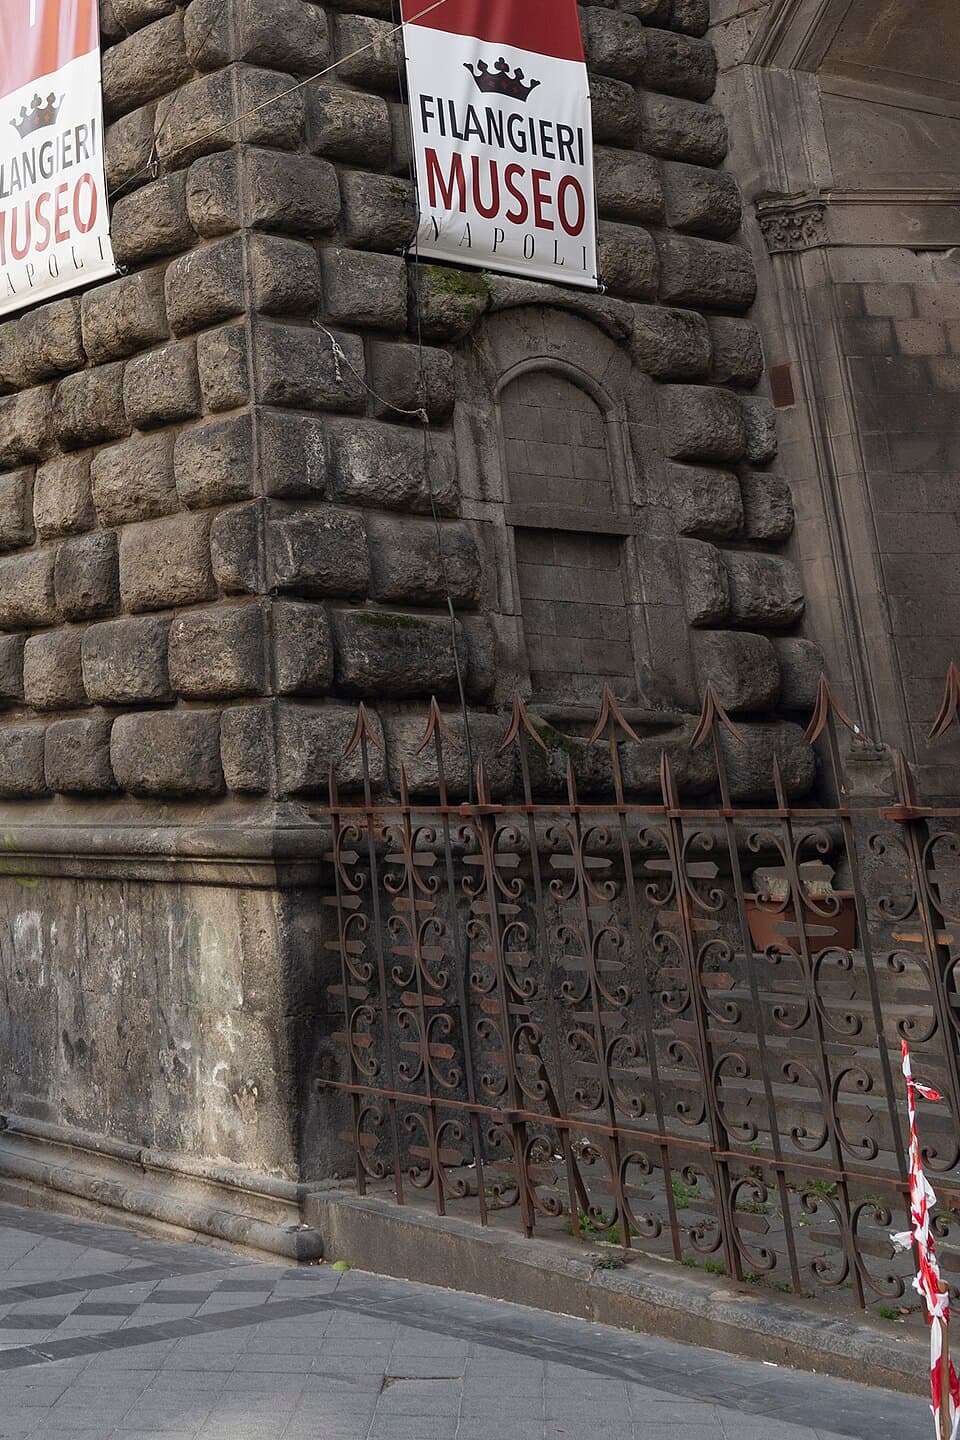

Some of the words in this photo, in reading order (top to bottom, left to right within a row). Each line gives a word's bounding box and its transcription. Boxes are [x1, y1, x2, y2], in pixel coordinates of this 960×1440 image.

[419, 94, 585, 166] FILANGIERI
[424, 147, 586, 237] MUSEO
[425, 215, 588, 270] NAPOLI
